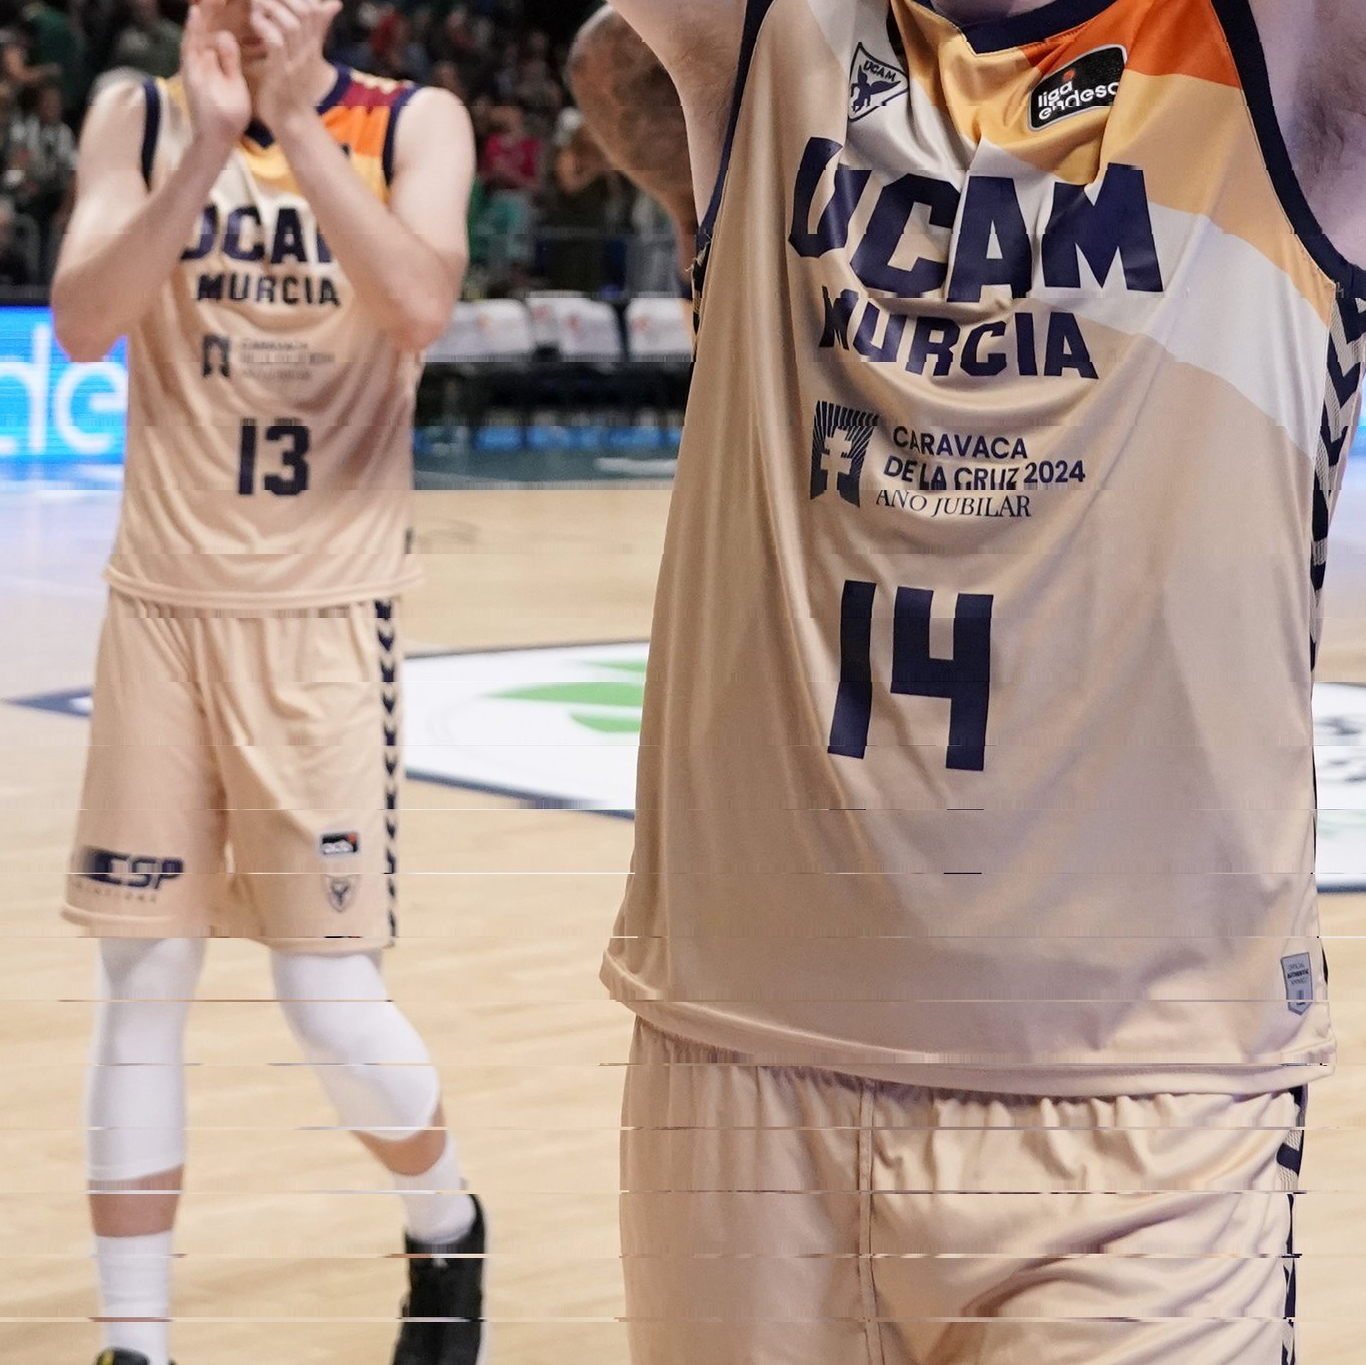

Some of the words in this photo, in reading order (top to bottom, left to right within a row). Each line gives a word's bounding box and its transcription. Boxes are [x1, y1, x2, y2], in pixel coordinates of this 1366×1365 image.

[863, 60, 896, 82] UCAM
[1038, 81, 1073, 108] liga
[788, 137, 1164, 303] UCAM
[197, 272, 341, 307] MURCIA
[819, 285, 1099, 380] MURCIA
[238, 417, 310, 497] 13
[893, 425, 1028, 459] CARAVACA
[884, 455, 917, 482] DE
[919, 462, 947, 490] LA
[953, 466, 1019, 491] CRUZ
[1024, 460, 1086, 485] 2024
[931, 495, 1032, 518] JUBILAR
[828, 580, 995, 772] 14
